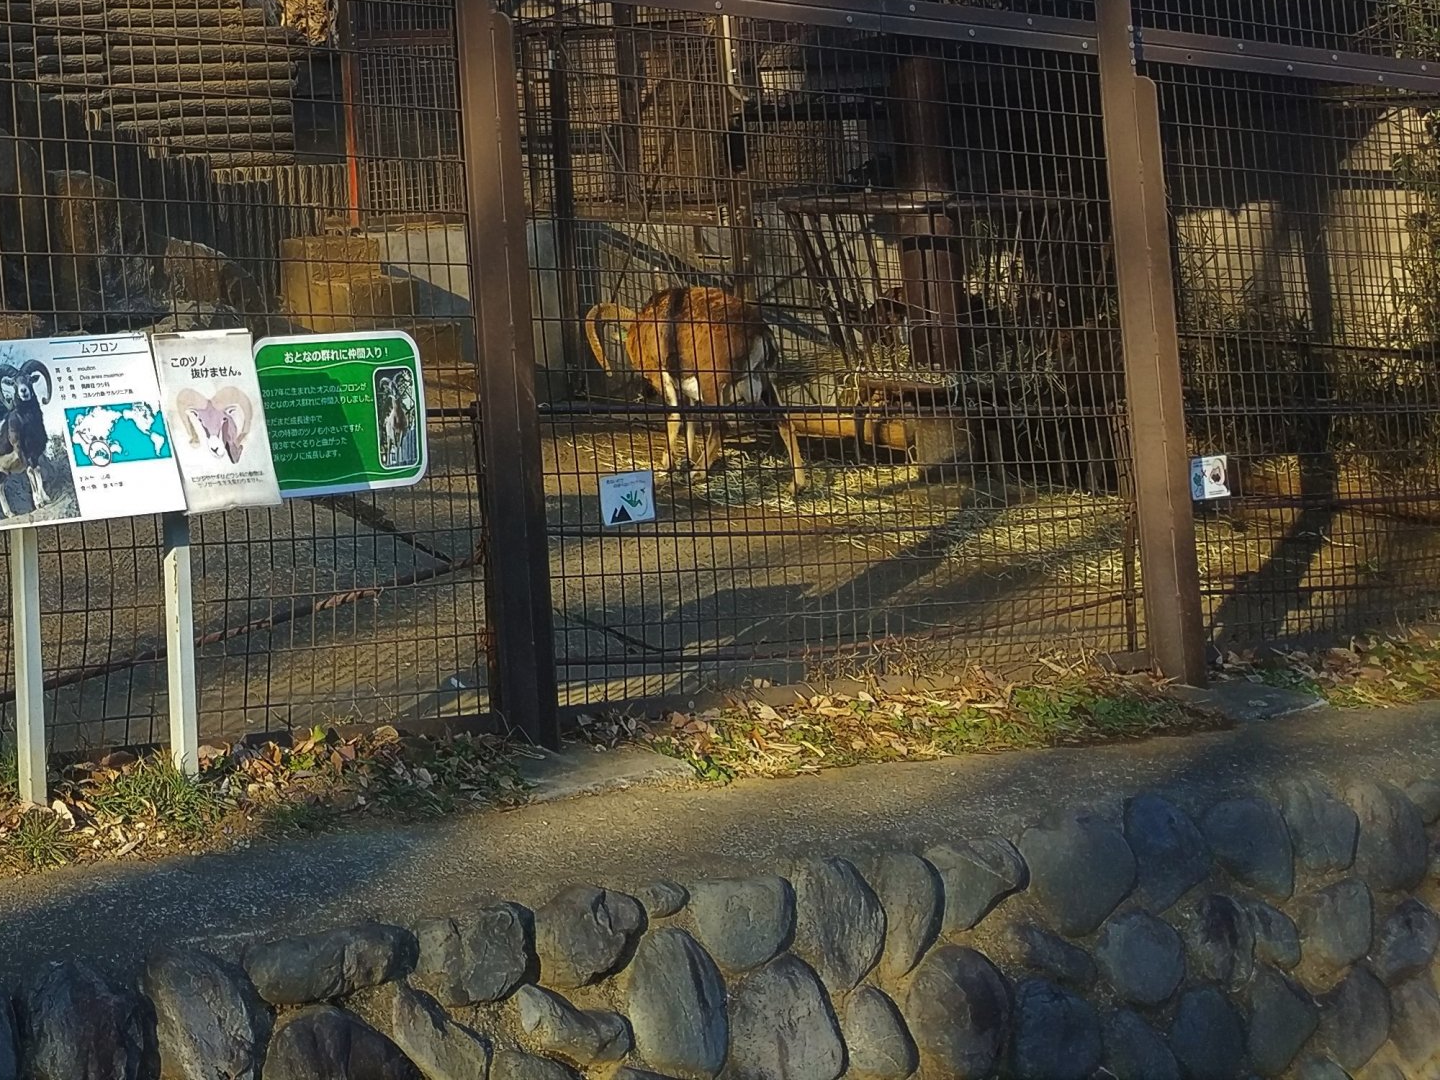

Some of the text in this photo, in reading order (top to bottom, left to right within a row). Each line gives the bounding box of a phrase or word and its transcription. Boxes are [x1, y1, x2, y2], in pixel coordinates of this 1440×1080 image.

[81, 342, 118, 354] ムフロン
[170, 355, 206, 368] このツノ
[190, 366, 242, 379] 抜けません。
